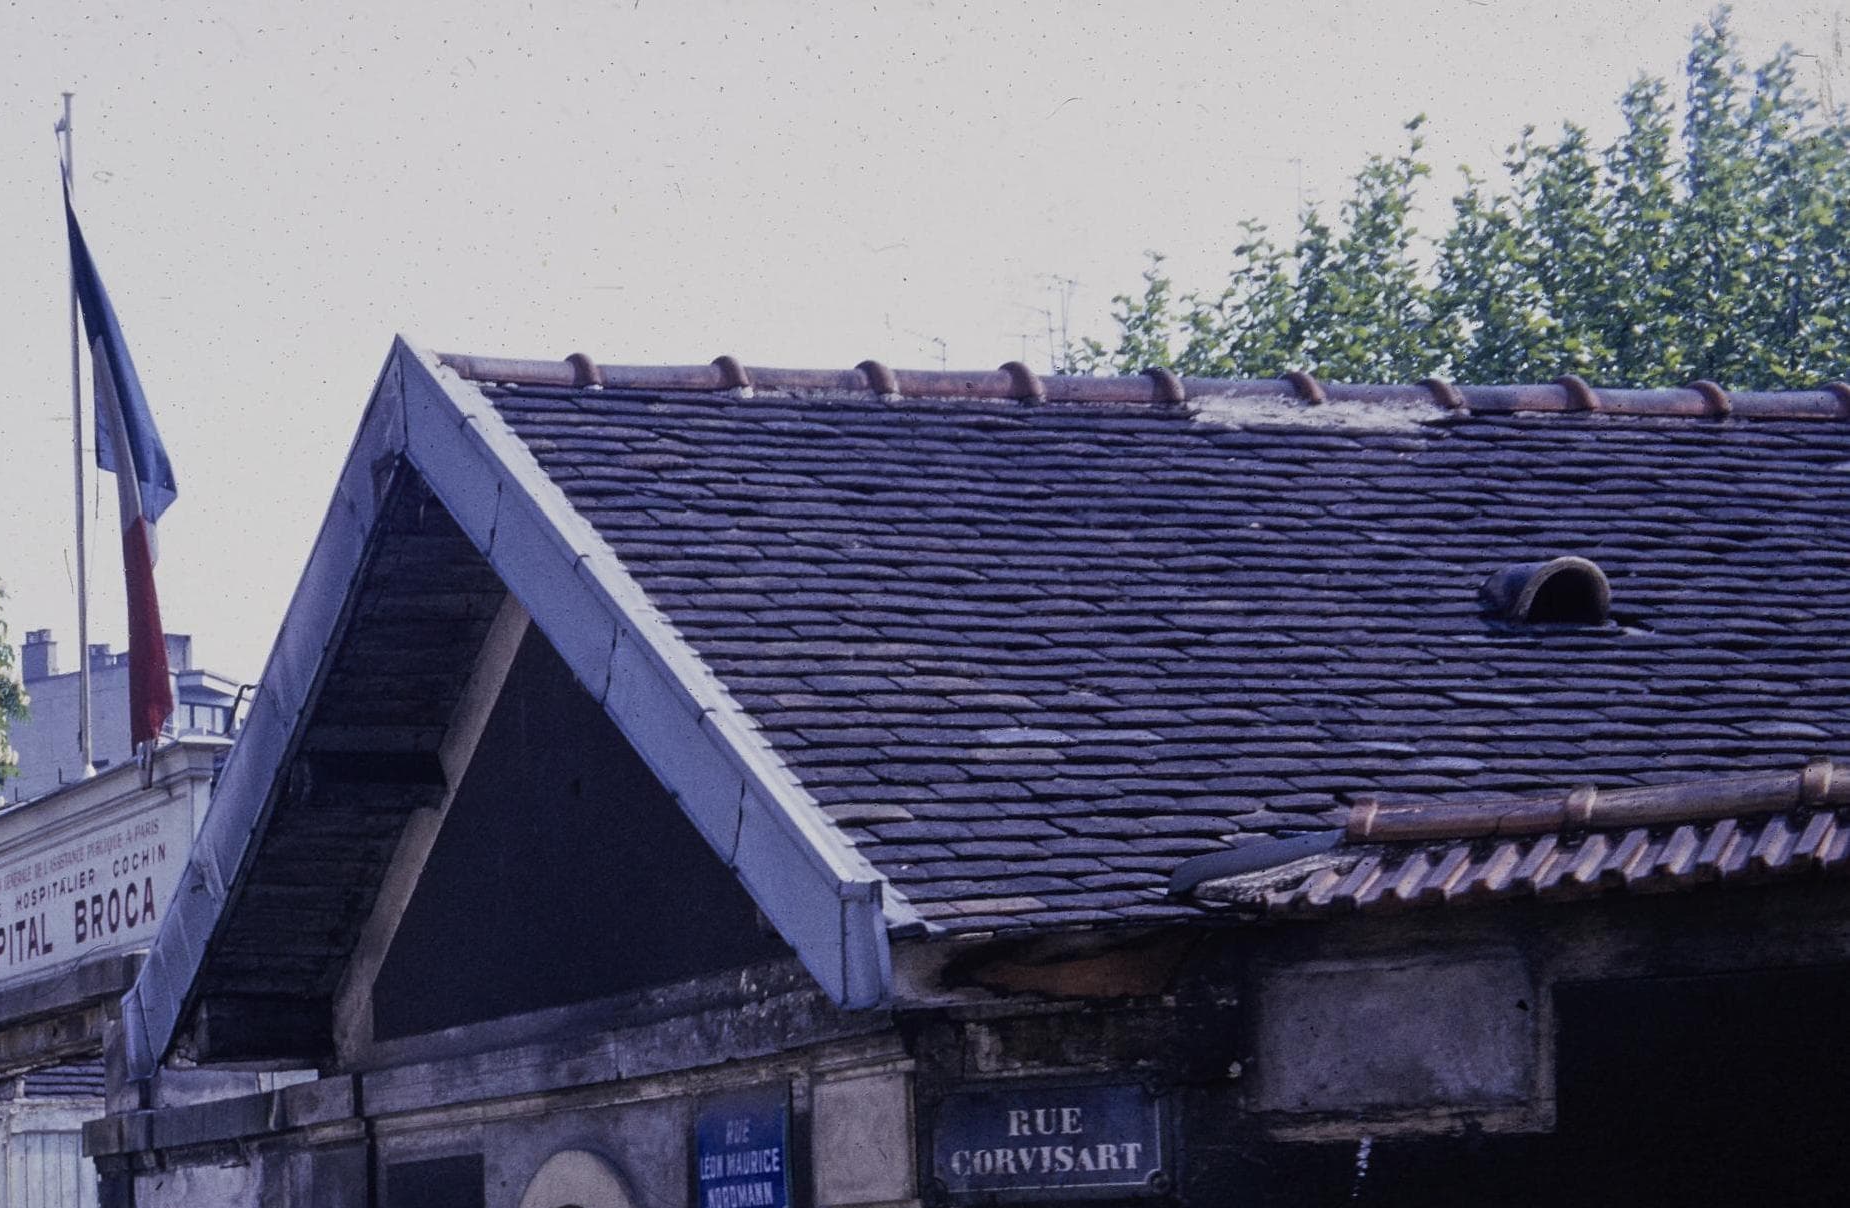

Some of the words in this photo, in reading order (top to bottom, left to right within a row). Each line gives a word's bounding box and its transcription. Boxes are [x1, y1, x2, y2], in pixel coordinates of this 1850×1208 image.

[133, 818, 160, 842] PARIS
[15, 867, 96, 911] HOSPITALIER
[112, 843, 167, 878] COCHIN
[74, 876, 156, 945] BROCA
[725, 1118, 750, 1145] RUE
[1007, 1107, 1083, 1137] RUE
[726, 1147, 780, 1177] MAURICE
[951, 1142, 1143, 1176] CORVISART
